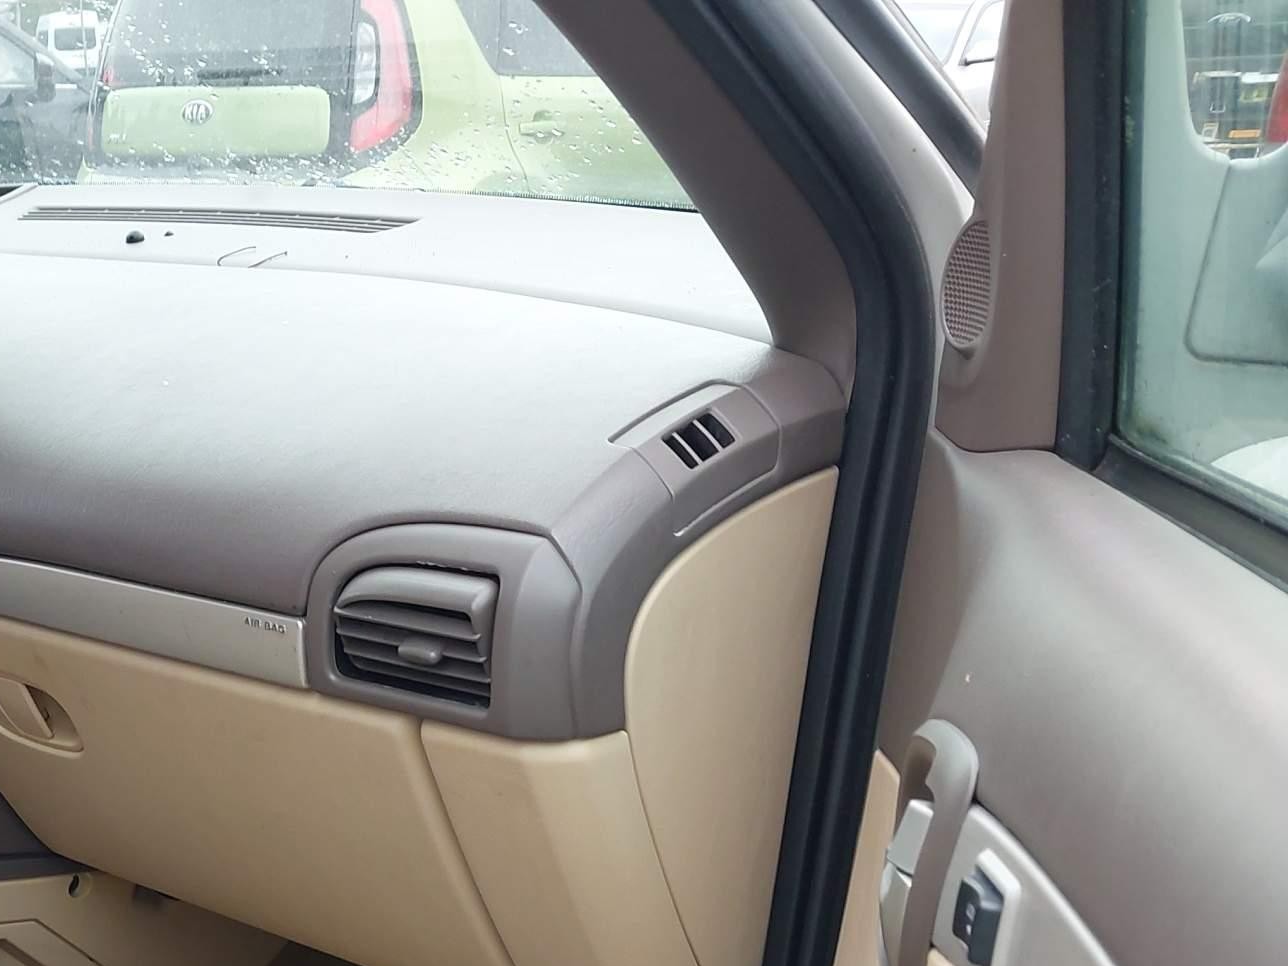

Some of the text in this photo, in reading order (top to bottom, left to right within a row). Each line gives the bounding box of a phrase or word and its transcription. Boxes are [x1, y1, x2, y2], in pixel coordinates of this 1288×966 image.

[184, 103, 207, 124] KIA
[244, 616, 287, 634] AIR BAG
